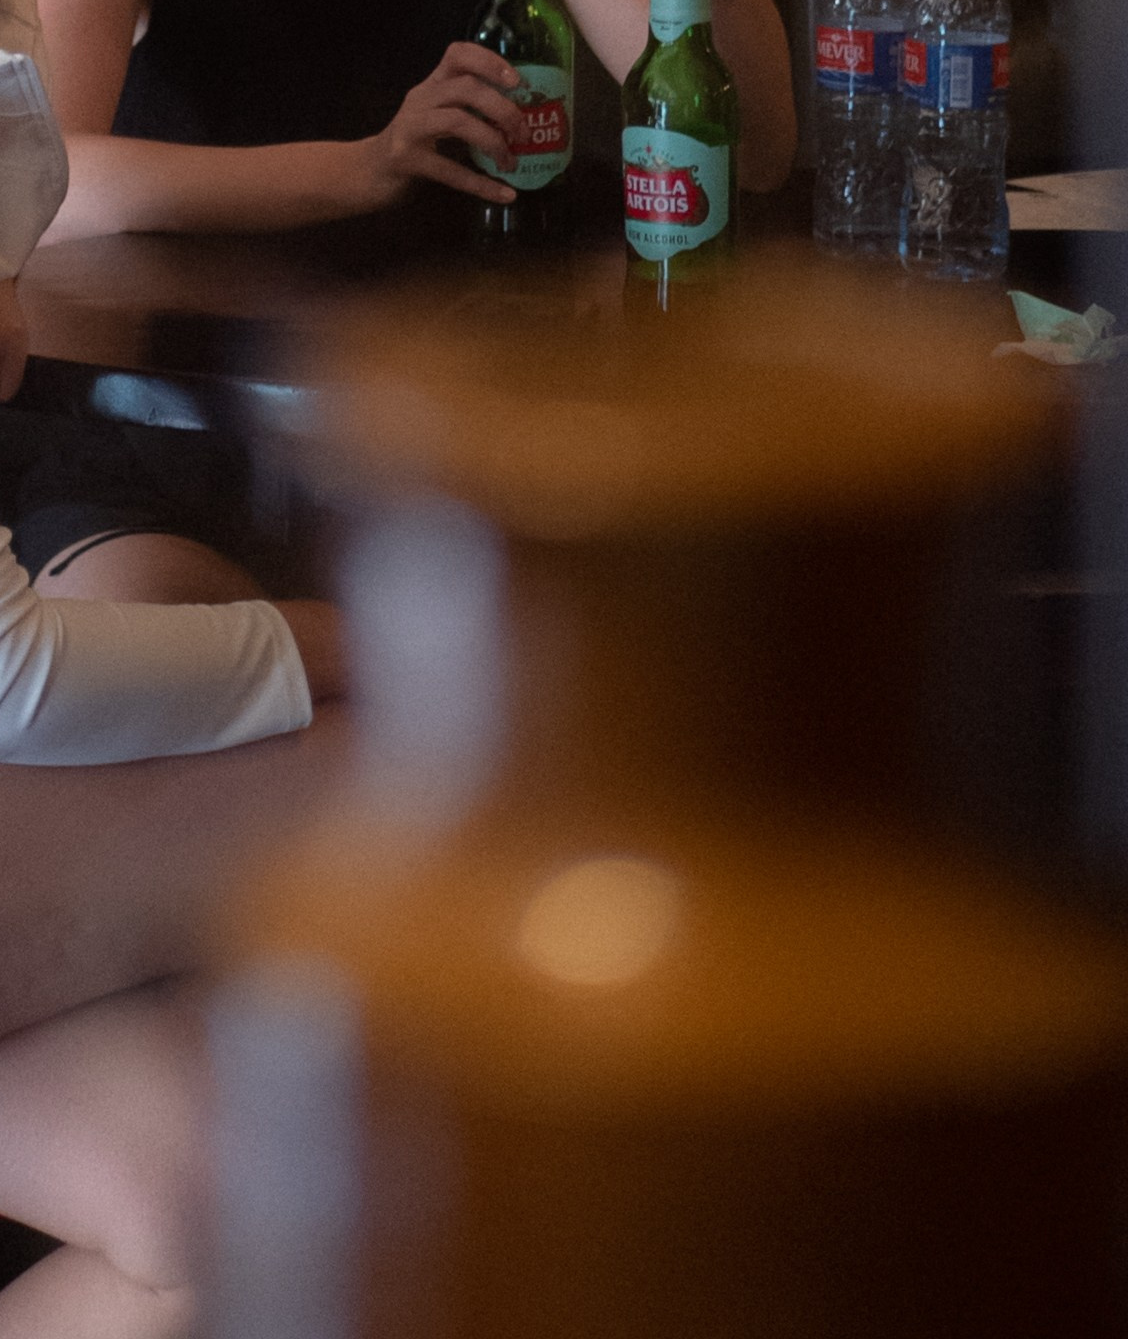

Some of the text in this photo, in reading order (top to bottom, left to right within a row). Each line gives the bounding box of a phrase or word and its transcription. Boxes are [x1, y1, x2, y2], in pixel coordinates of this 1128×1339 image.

[627, 174, 688, 196] STELLA
[627, 193, 690, 214] ARTOIS
[643, 233, 690, 246] ALCOHOL
